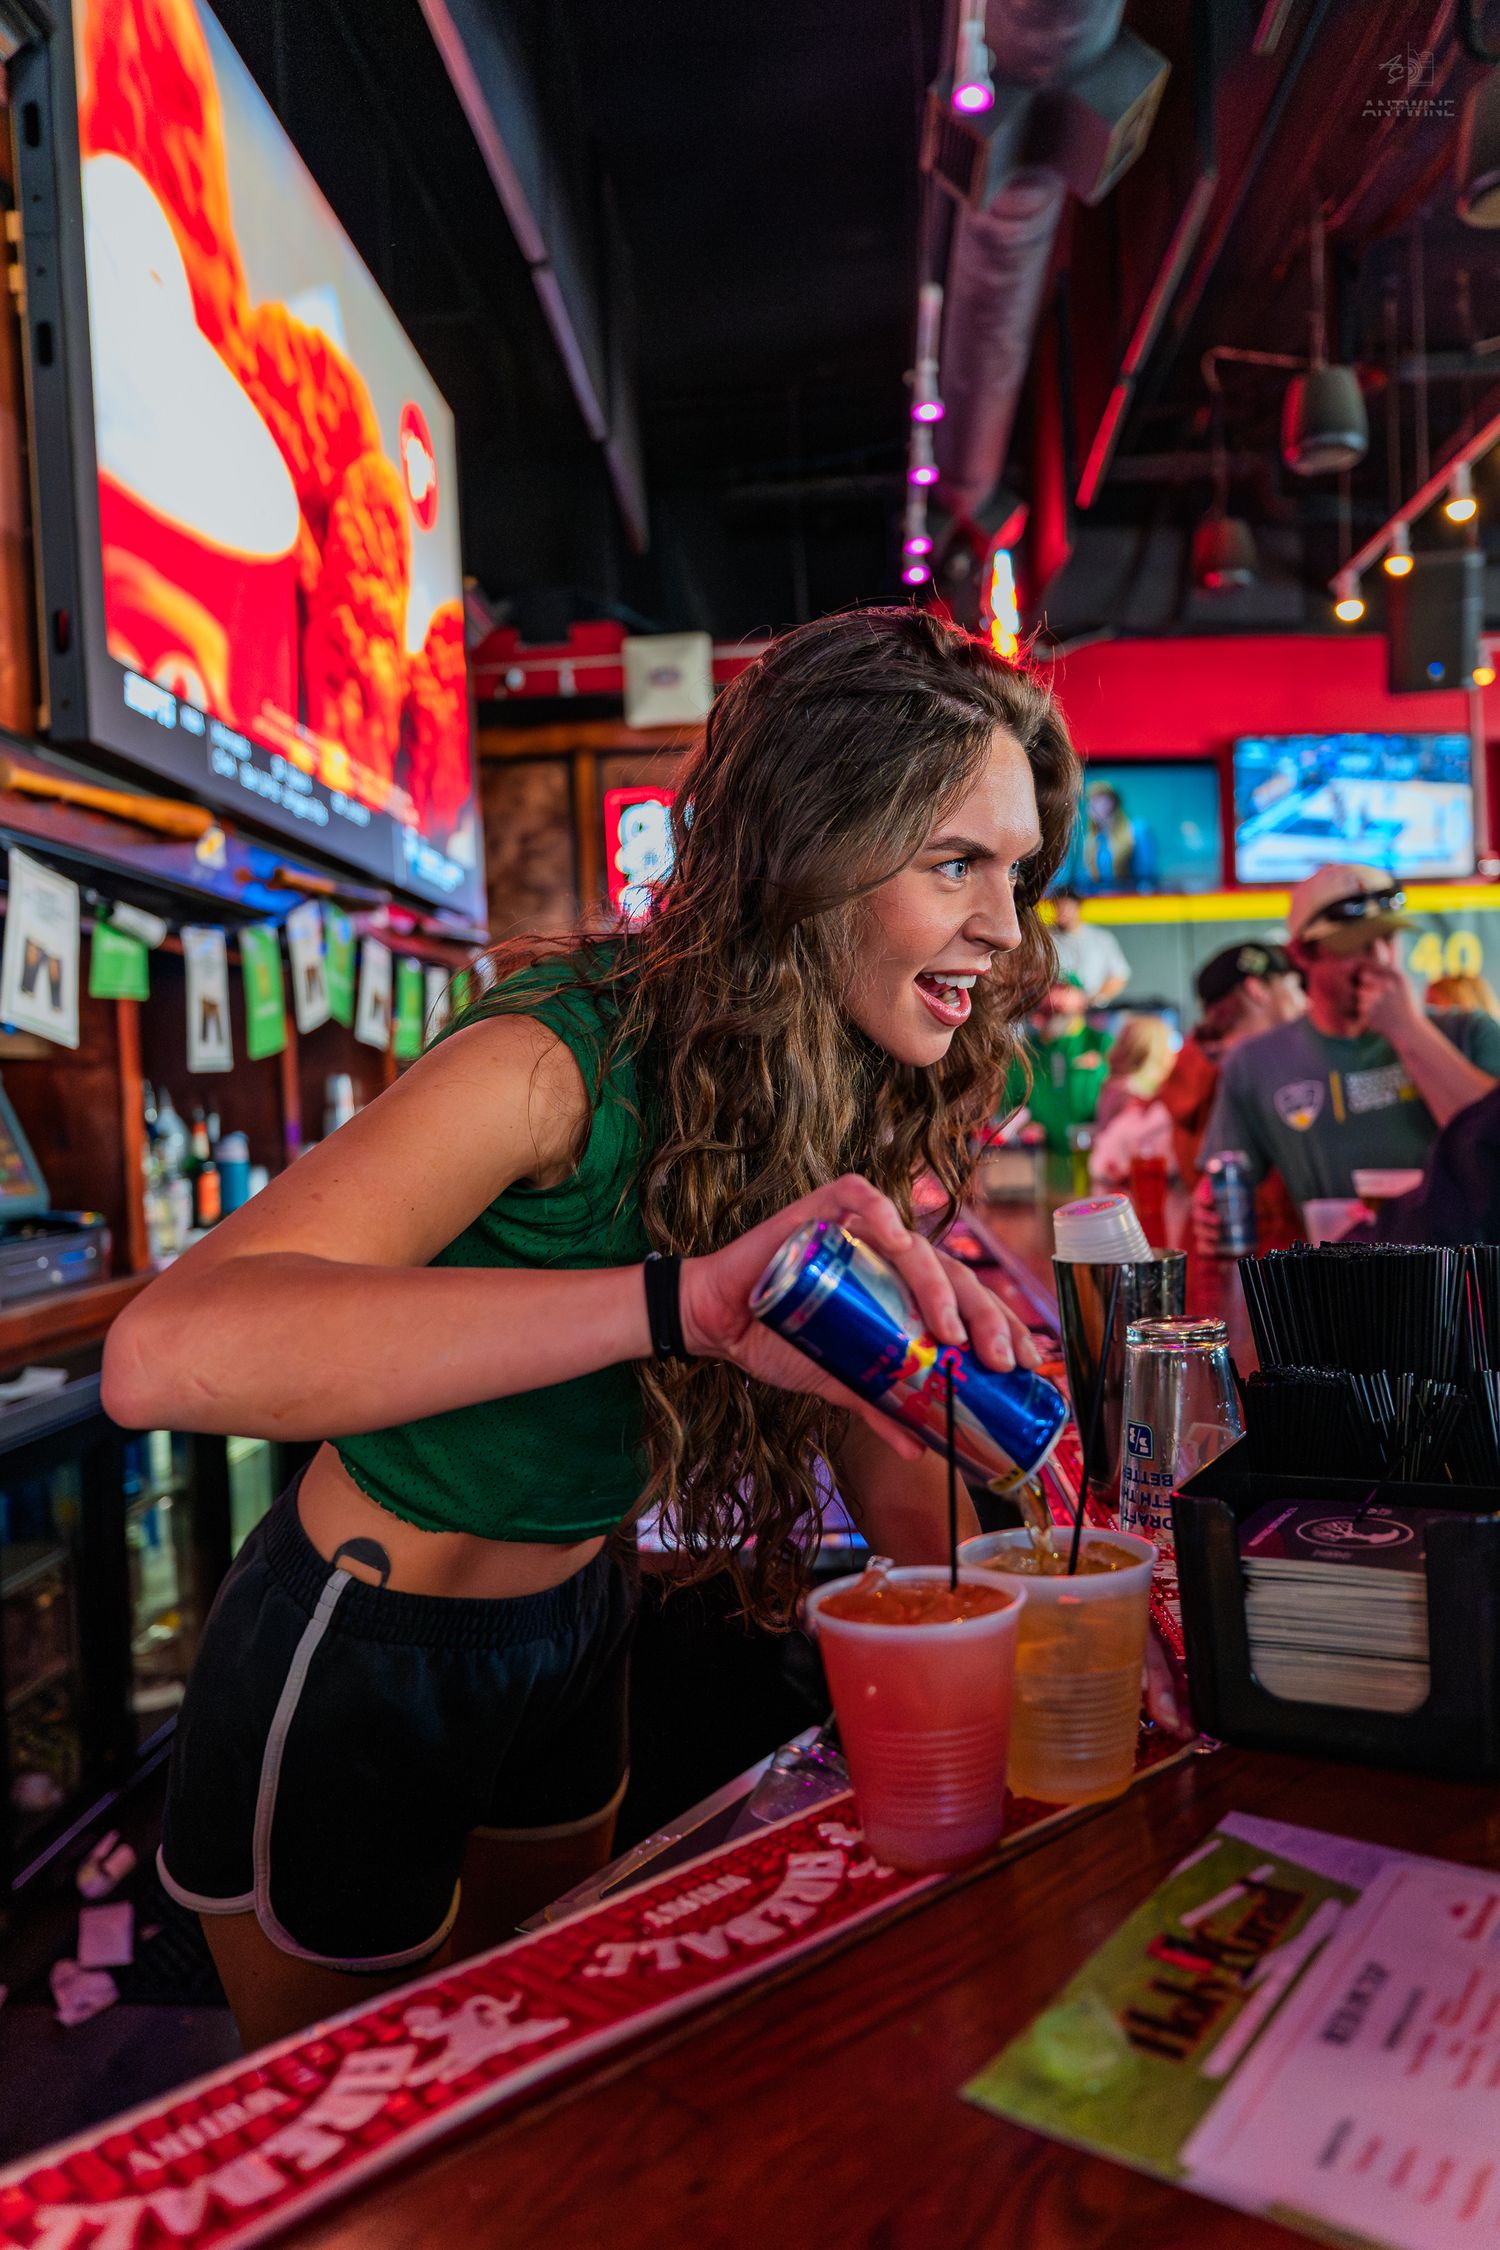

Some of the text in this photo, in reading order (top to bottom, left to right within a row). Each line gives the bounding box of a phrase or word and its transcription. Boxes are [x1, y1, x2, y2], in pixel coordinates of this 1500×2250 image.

[1408, 930, 1483, 982] 40
[1140, 1491, 1172, 1508] FTH
[1123, 1509, 1175, 1531] DRAFT
[583, 1849, 845, 1977] FIREBALL
